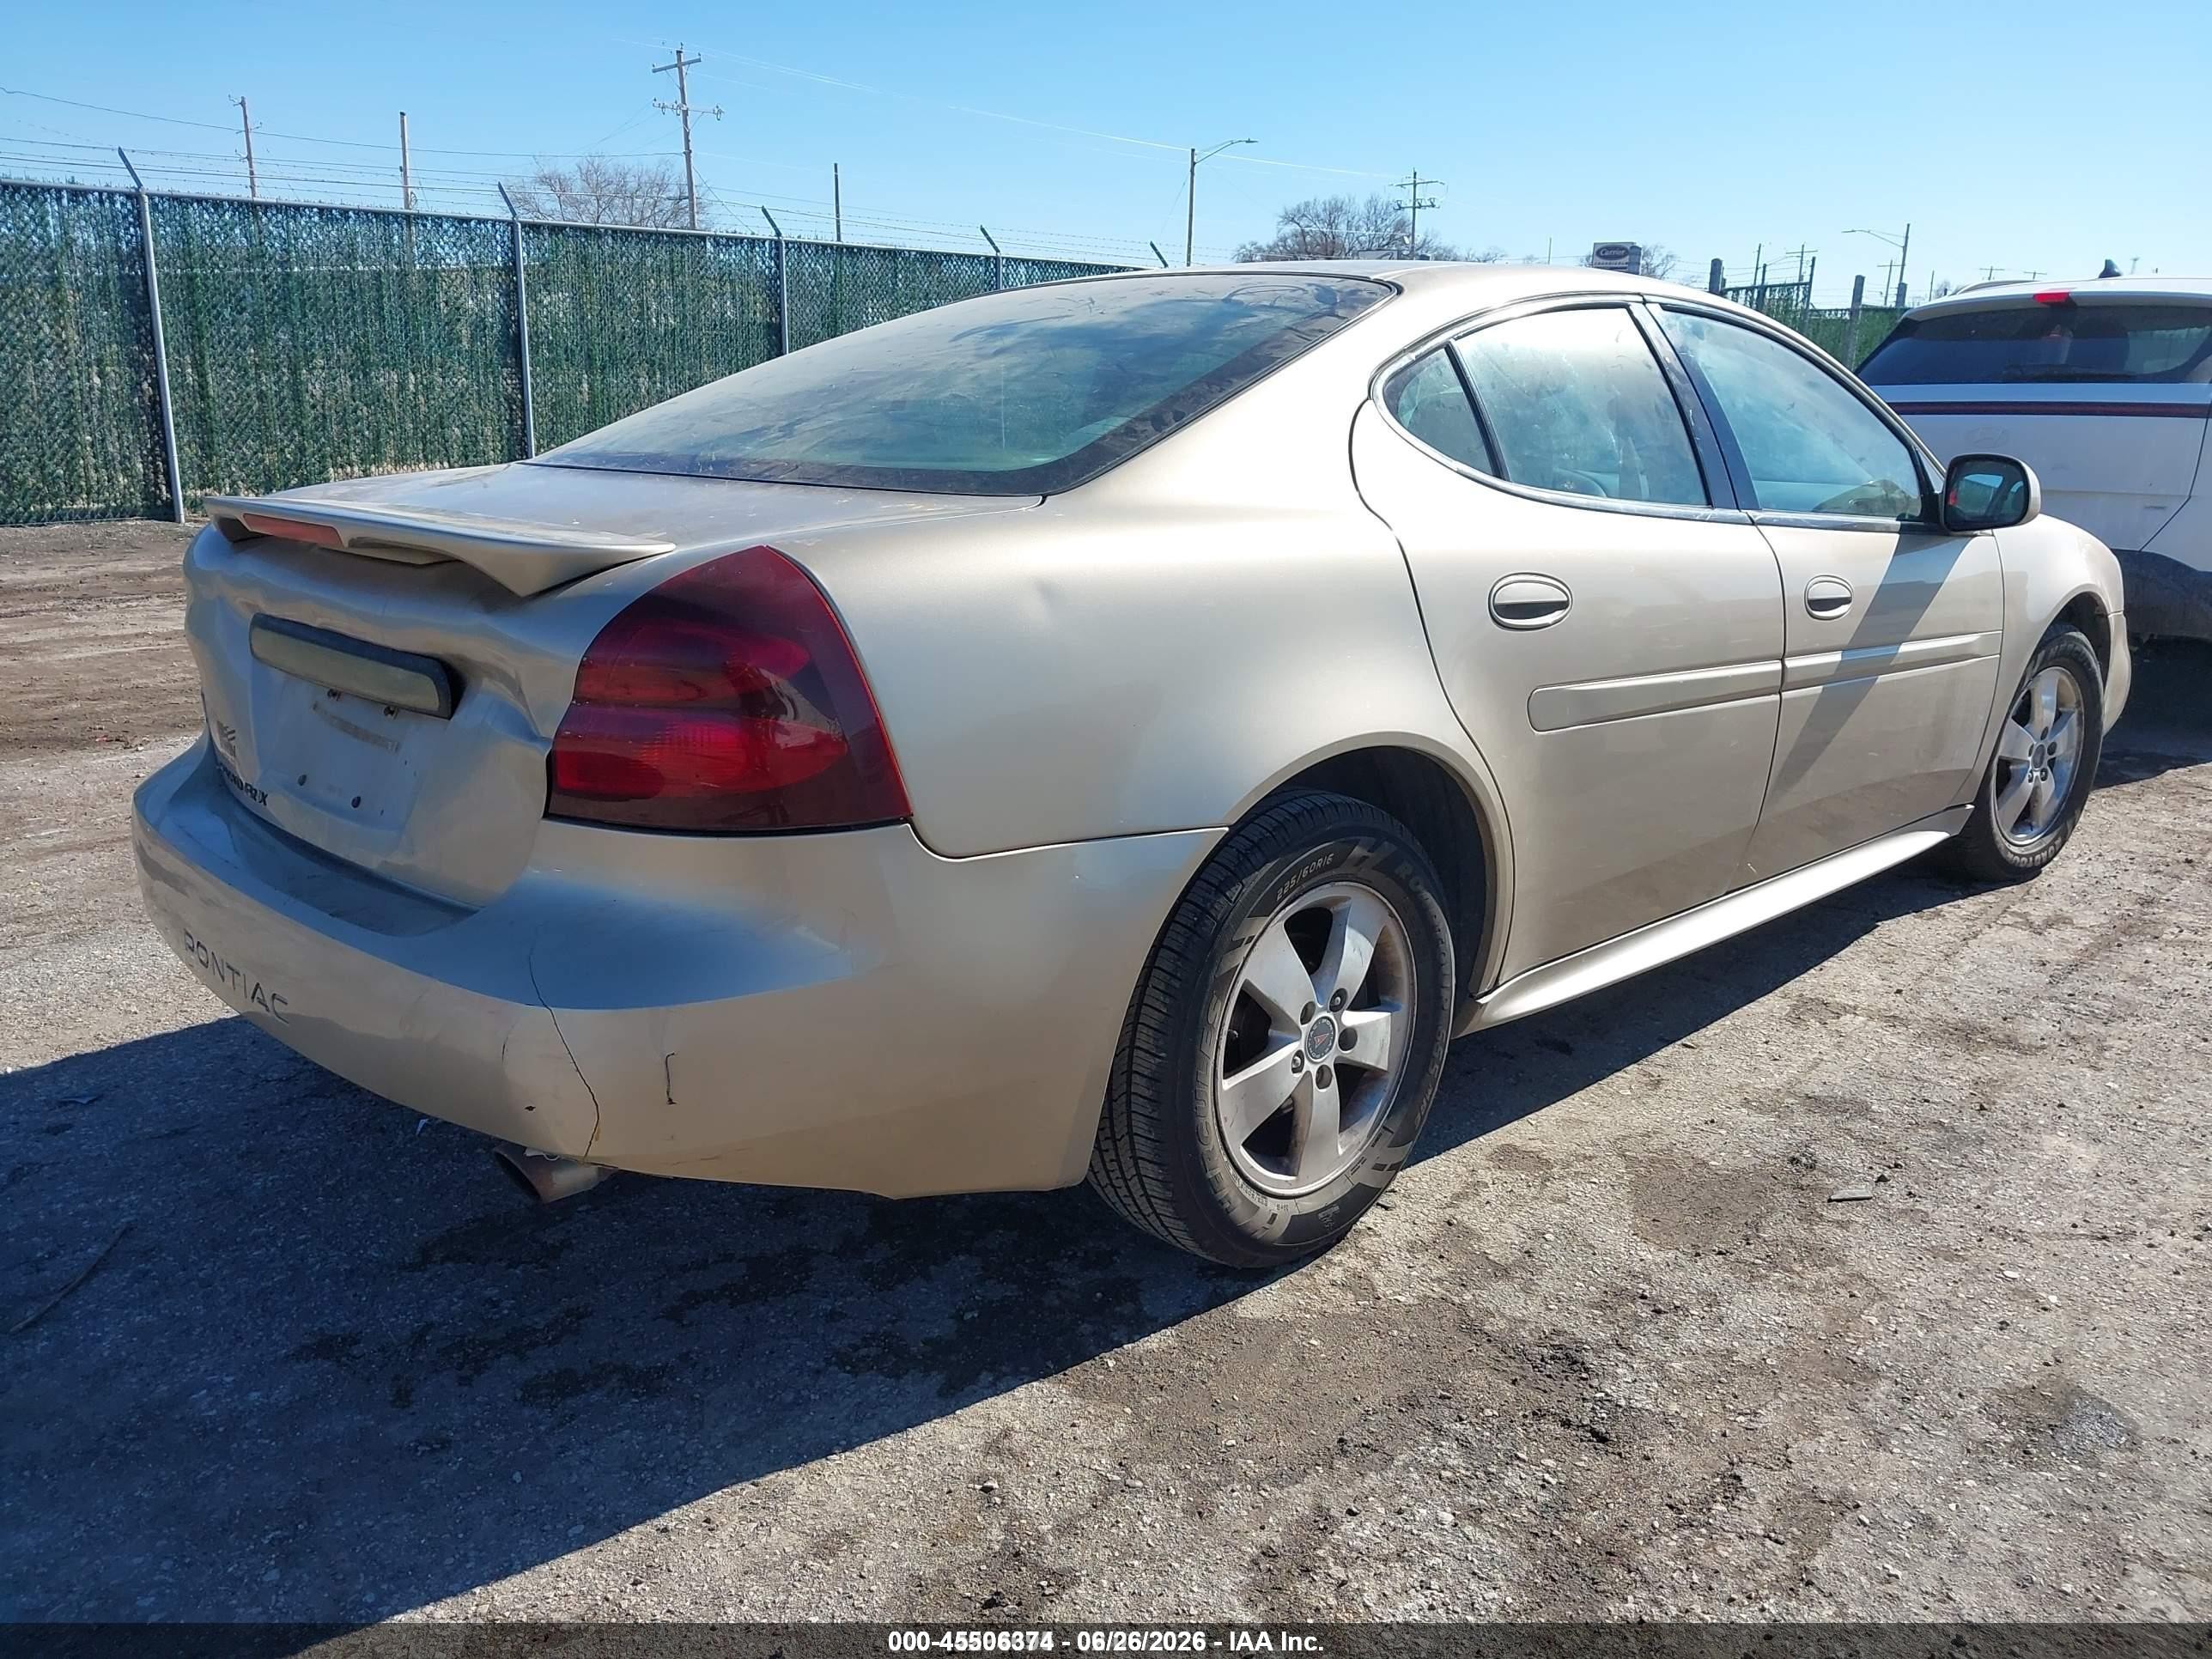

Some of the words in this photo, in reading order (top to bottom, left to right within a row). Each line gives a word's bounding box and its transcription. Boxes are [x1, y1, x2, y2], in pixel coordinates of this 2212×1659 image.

[244, 781, 269, 806] PRIX
[2006, 836, 2063, 867] ROADTOUR
[1276, 853, 1334, 902] 225/60R16
[184, 927, 289, 1024] PONTIAC
